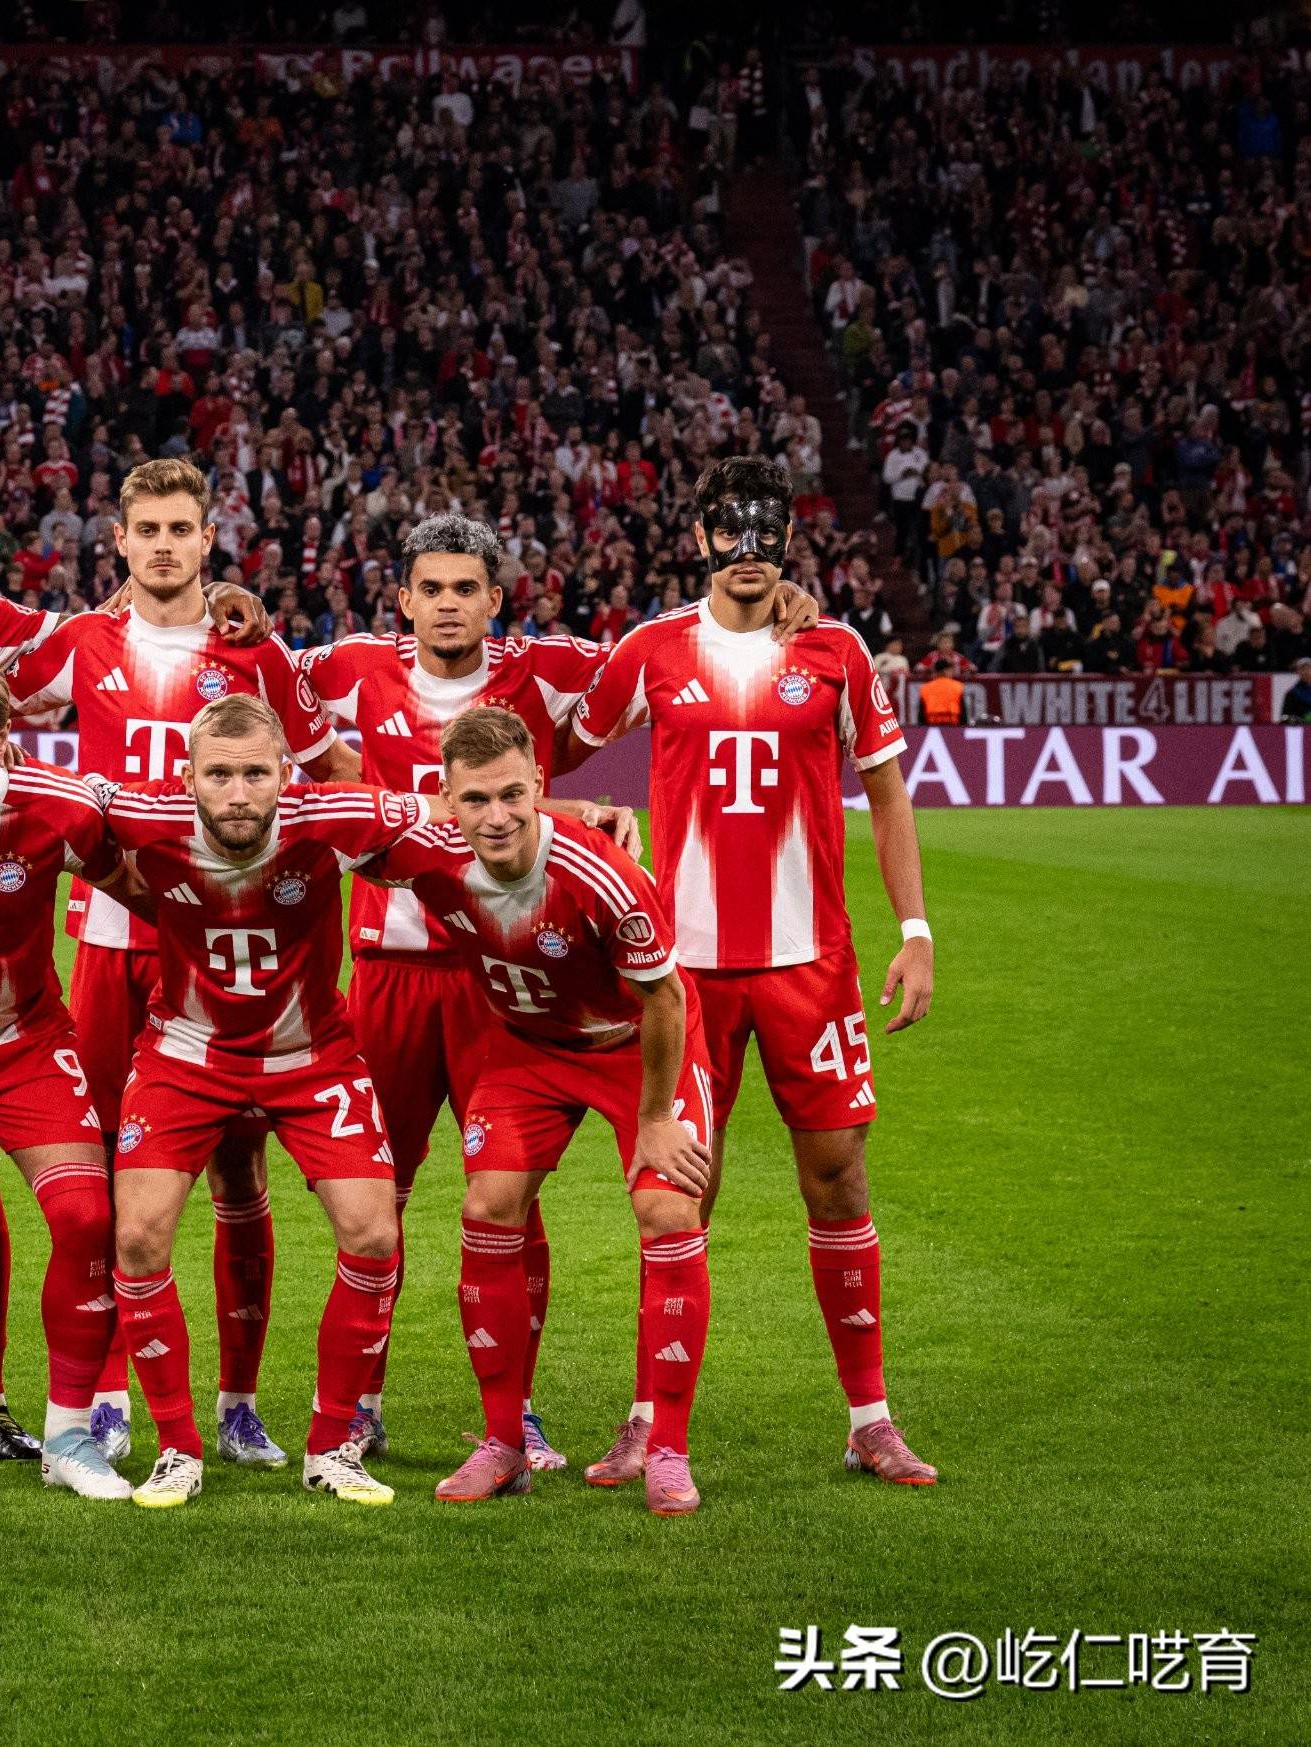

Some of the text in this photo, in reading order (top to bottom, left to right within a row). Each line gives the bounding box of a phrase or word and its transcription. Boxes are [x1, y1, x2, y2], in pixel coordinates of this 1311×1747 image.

[709, 731, 779, 814] T
[842, 724, 1167, 811] ATAR
[204, 928, 279, 996] T
[481, 954, 559, 1014] T
[53, 1048, 88, 1097] 9
[810, 1010, 871, 1081] 45
[313, 1077, 383, 1138] 27
